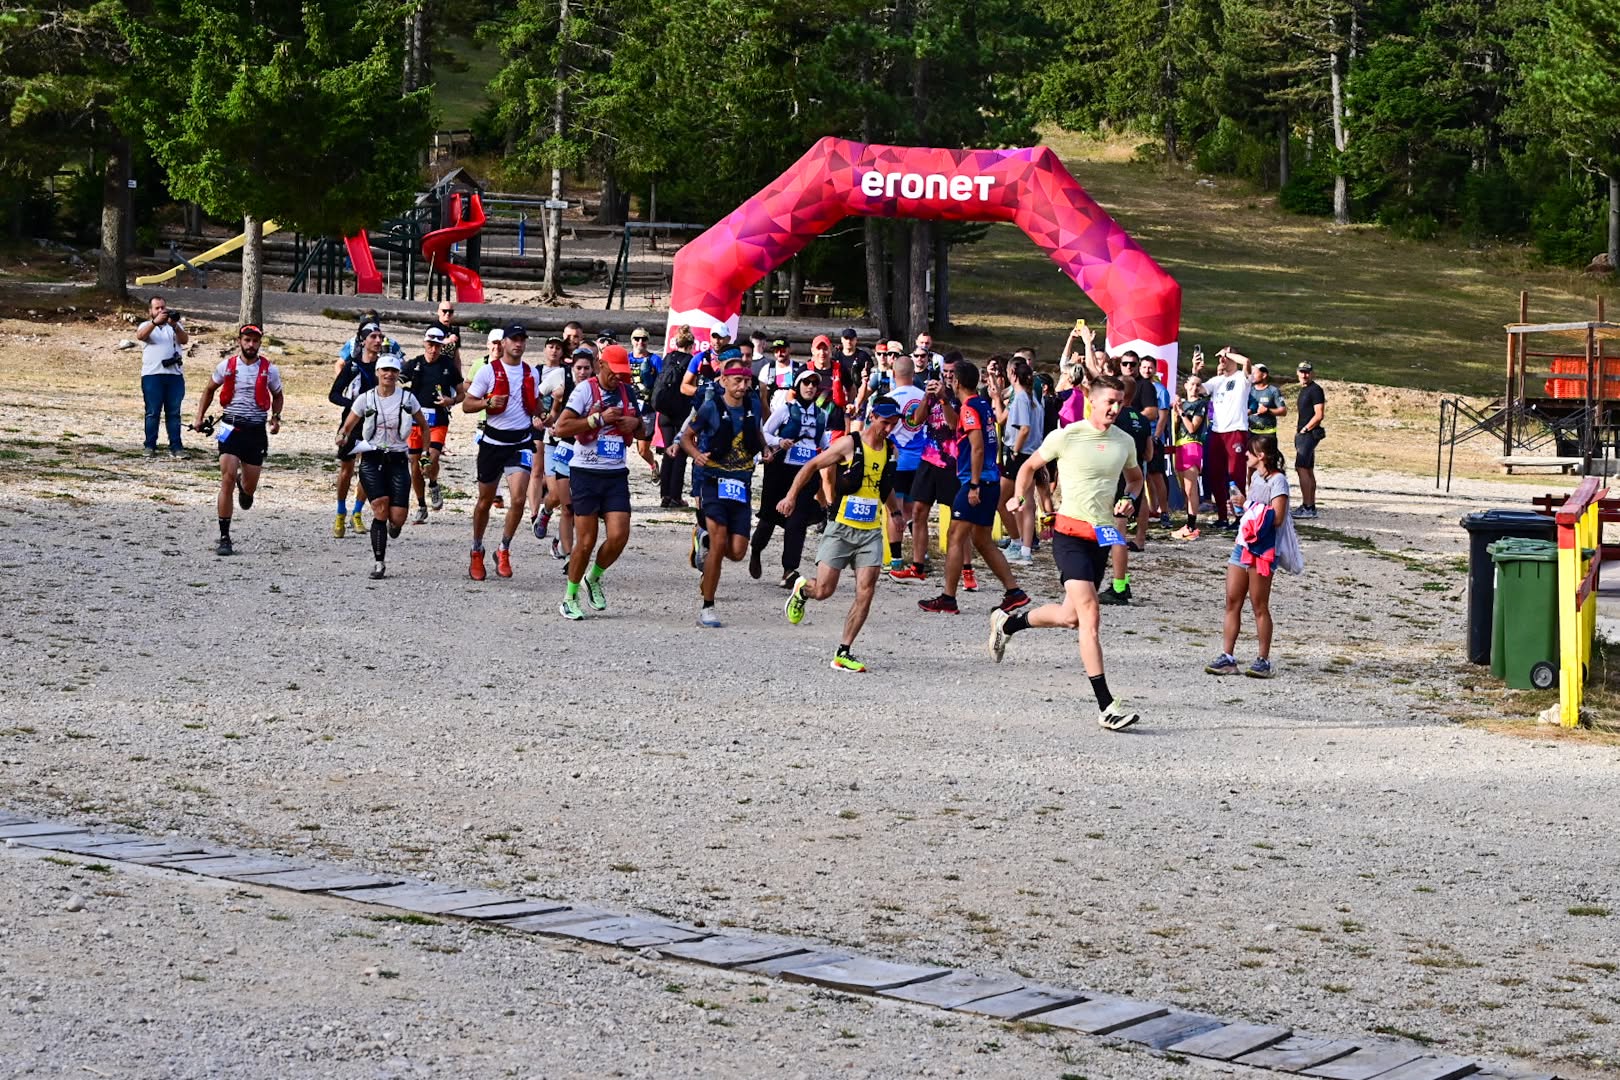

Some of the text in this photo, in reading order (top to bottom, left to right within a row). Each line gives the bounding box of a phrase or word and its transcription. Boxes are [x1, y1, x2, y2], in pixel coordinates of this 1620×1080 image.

[604, 442, 620, 452] 309
[797, 447, 811, 458] 333
[725, 484, 741, 495] 314
[852, 504, 871, 515] 335
